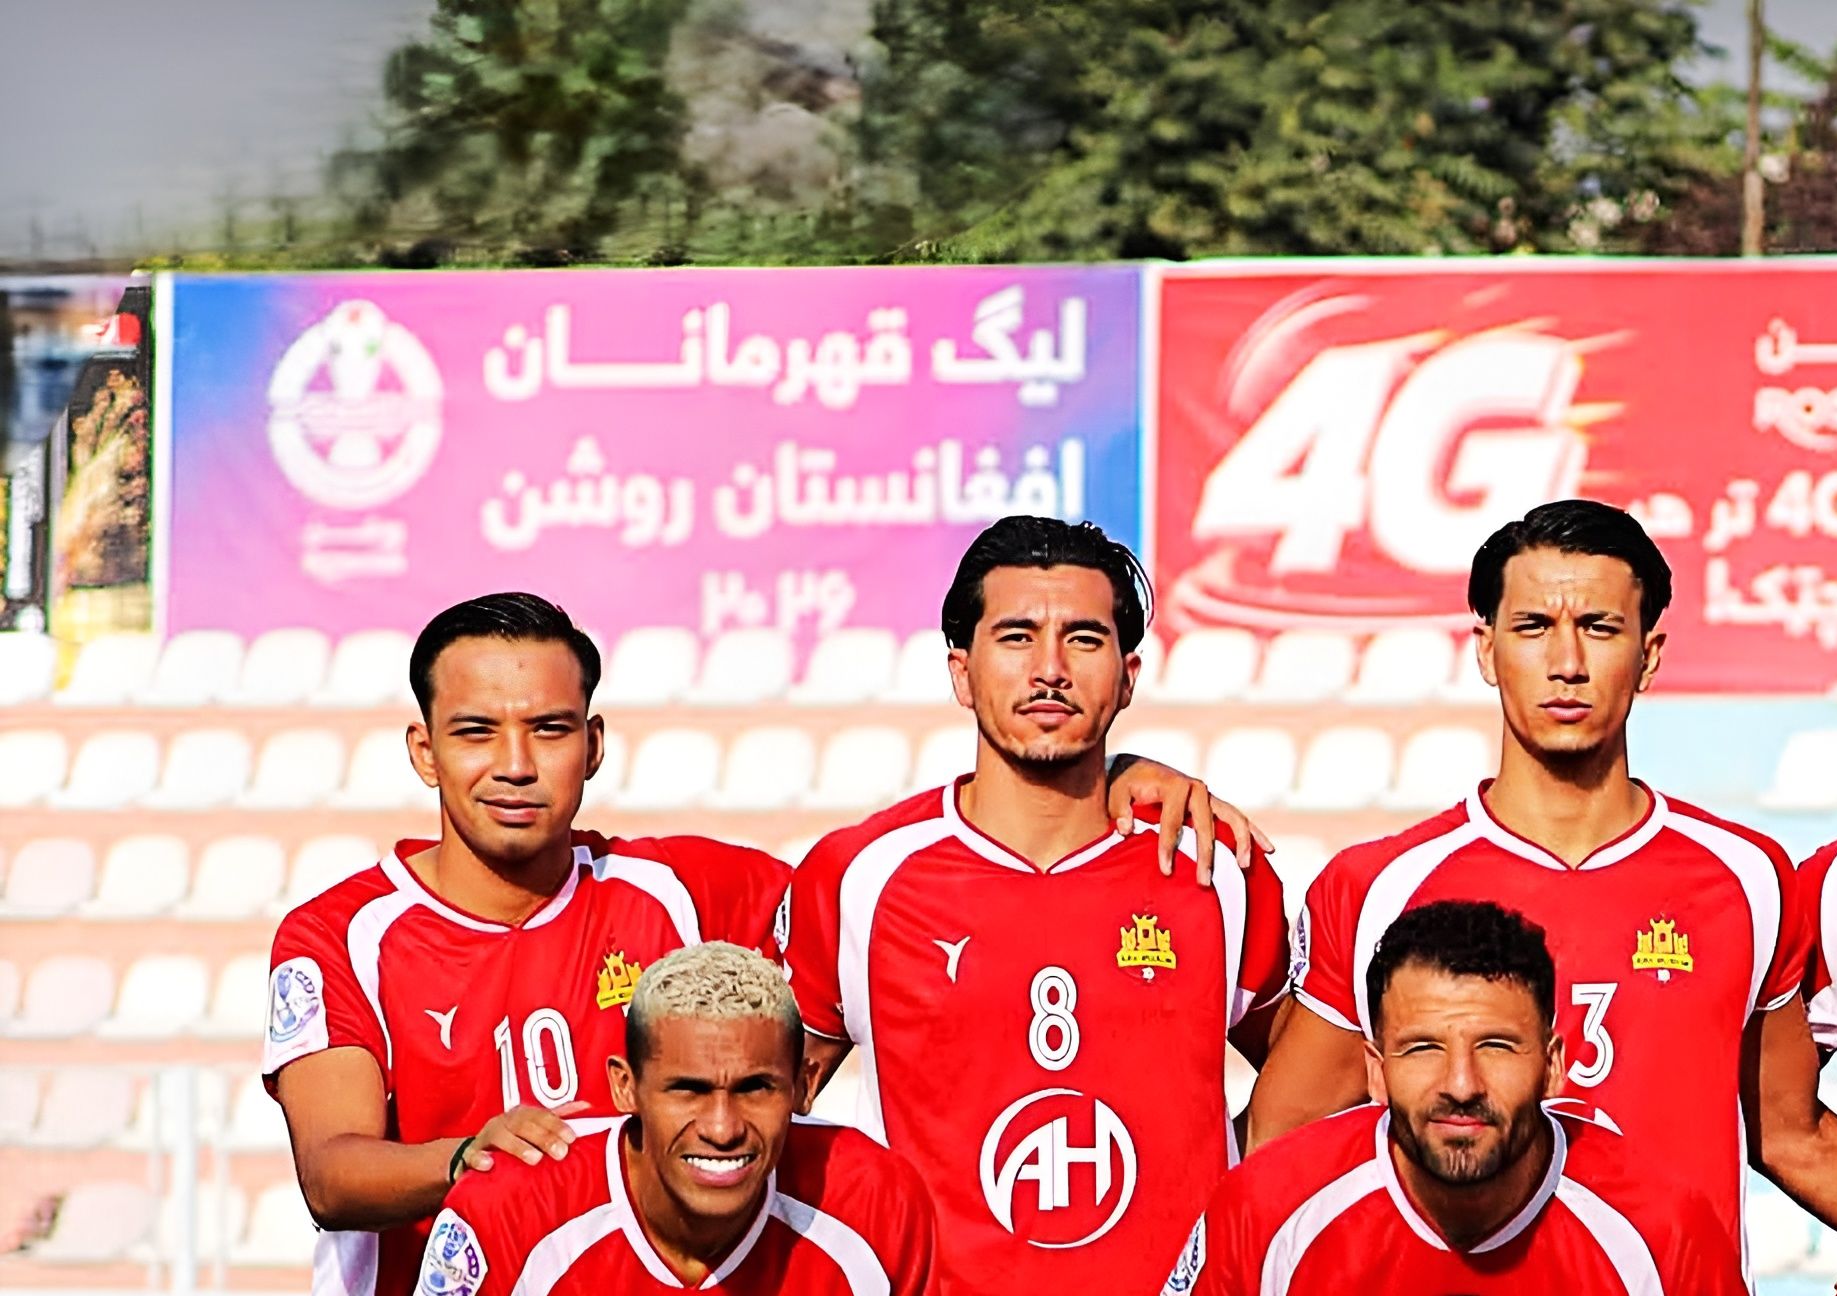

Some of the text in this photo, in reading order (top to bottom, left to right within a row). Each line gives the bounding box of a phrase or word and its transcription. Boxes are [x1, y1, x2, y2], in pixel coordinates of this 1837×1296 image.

[481, 434, 697, 552] روشن
[1191, 330, 1590, 575] 4G
[493, 1006, 580, 1112] 10
[1028, 965, 1081, 1072] 8
